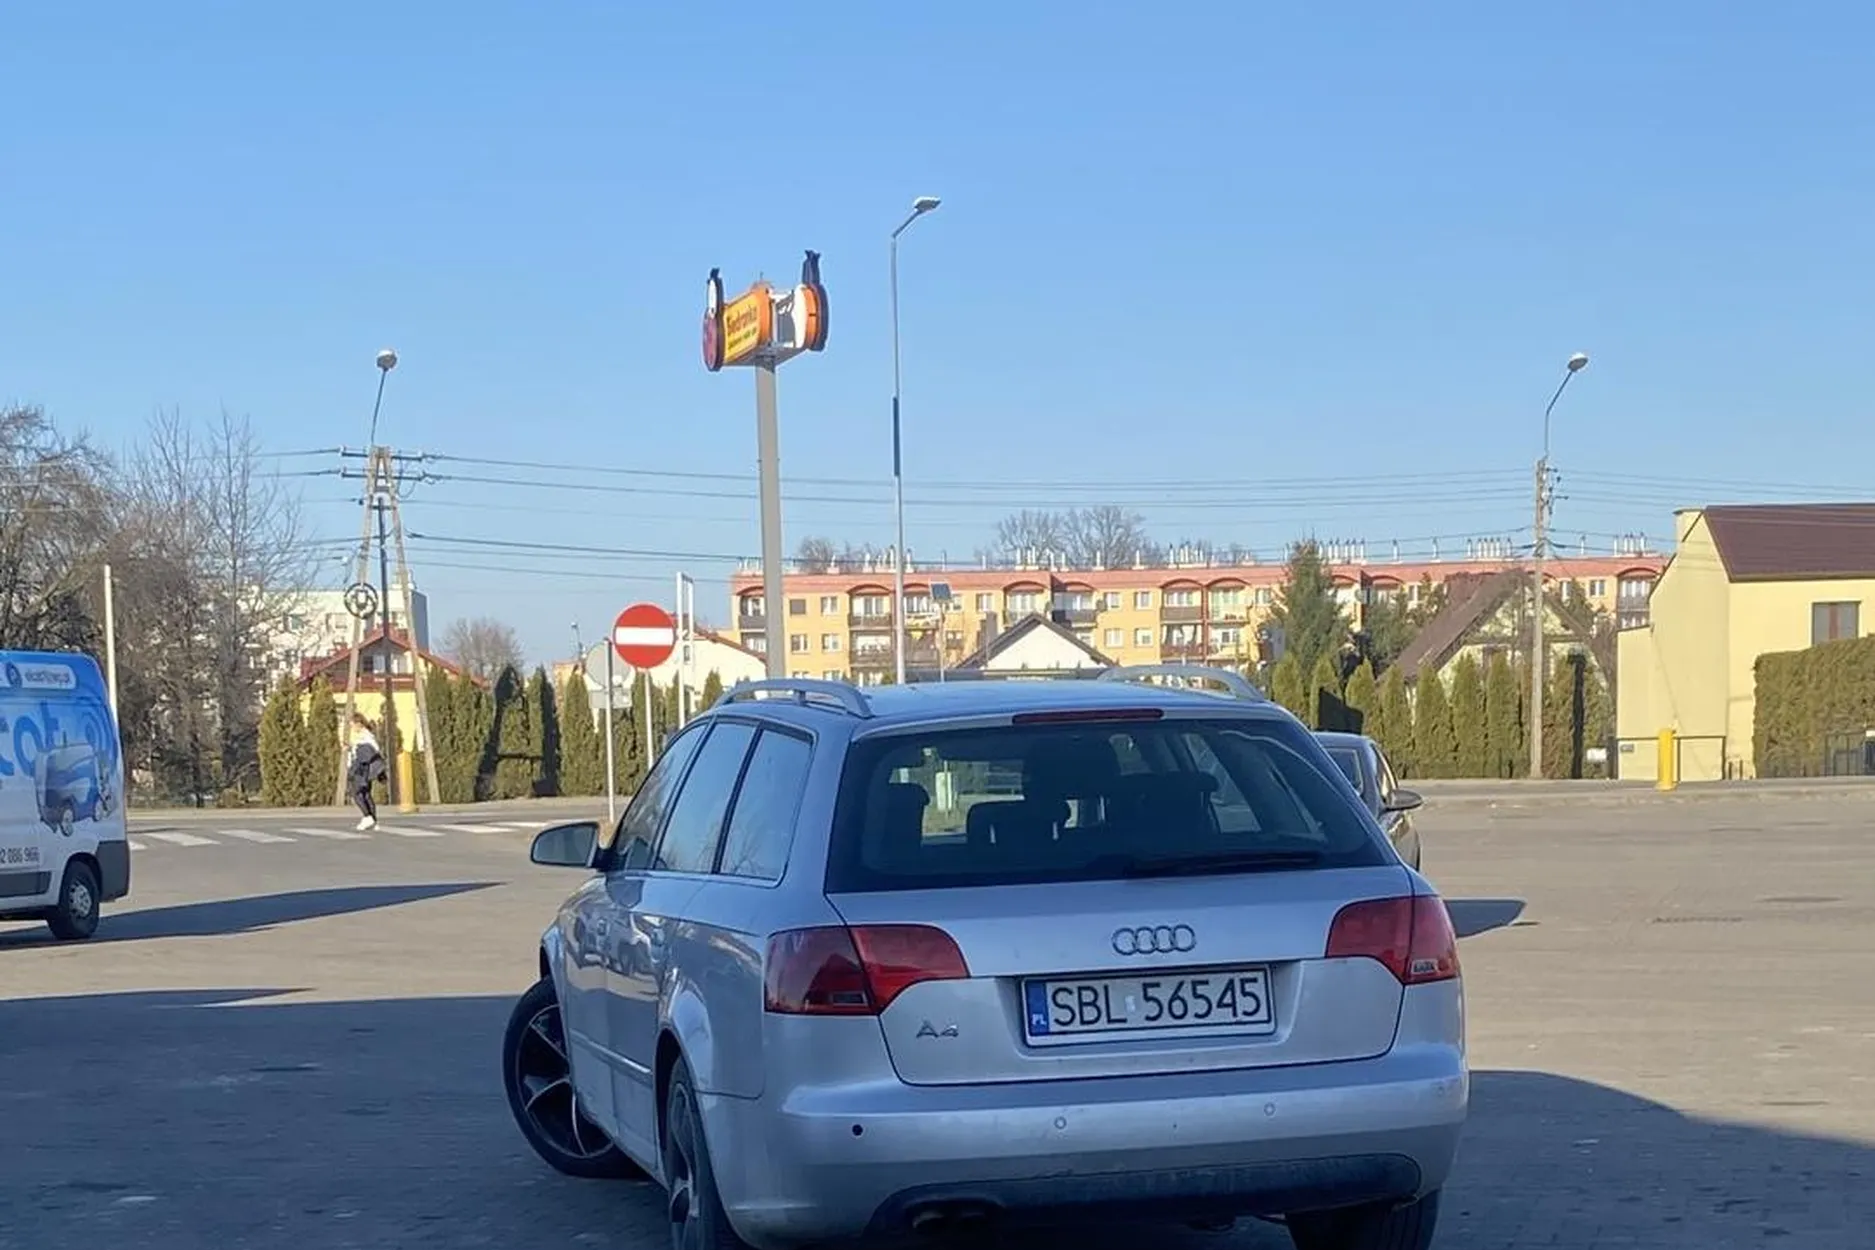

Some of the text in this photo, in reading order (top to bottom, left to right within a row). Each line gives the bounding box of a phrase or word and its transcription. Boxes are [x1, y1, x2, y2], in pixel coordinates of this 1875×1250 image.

[1051, 977, 1262, 1026] SBL 56545
[916, 1019, 959, 1039] A4
[1032, 1013, 1047, 1025] PL
